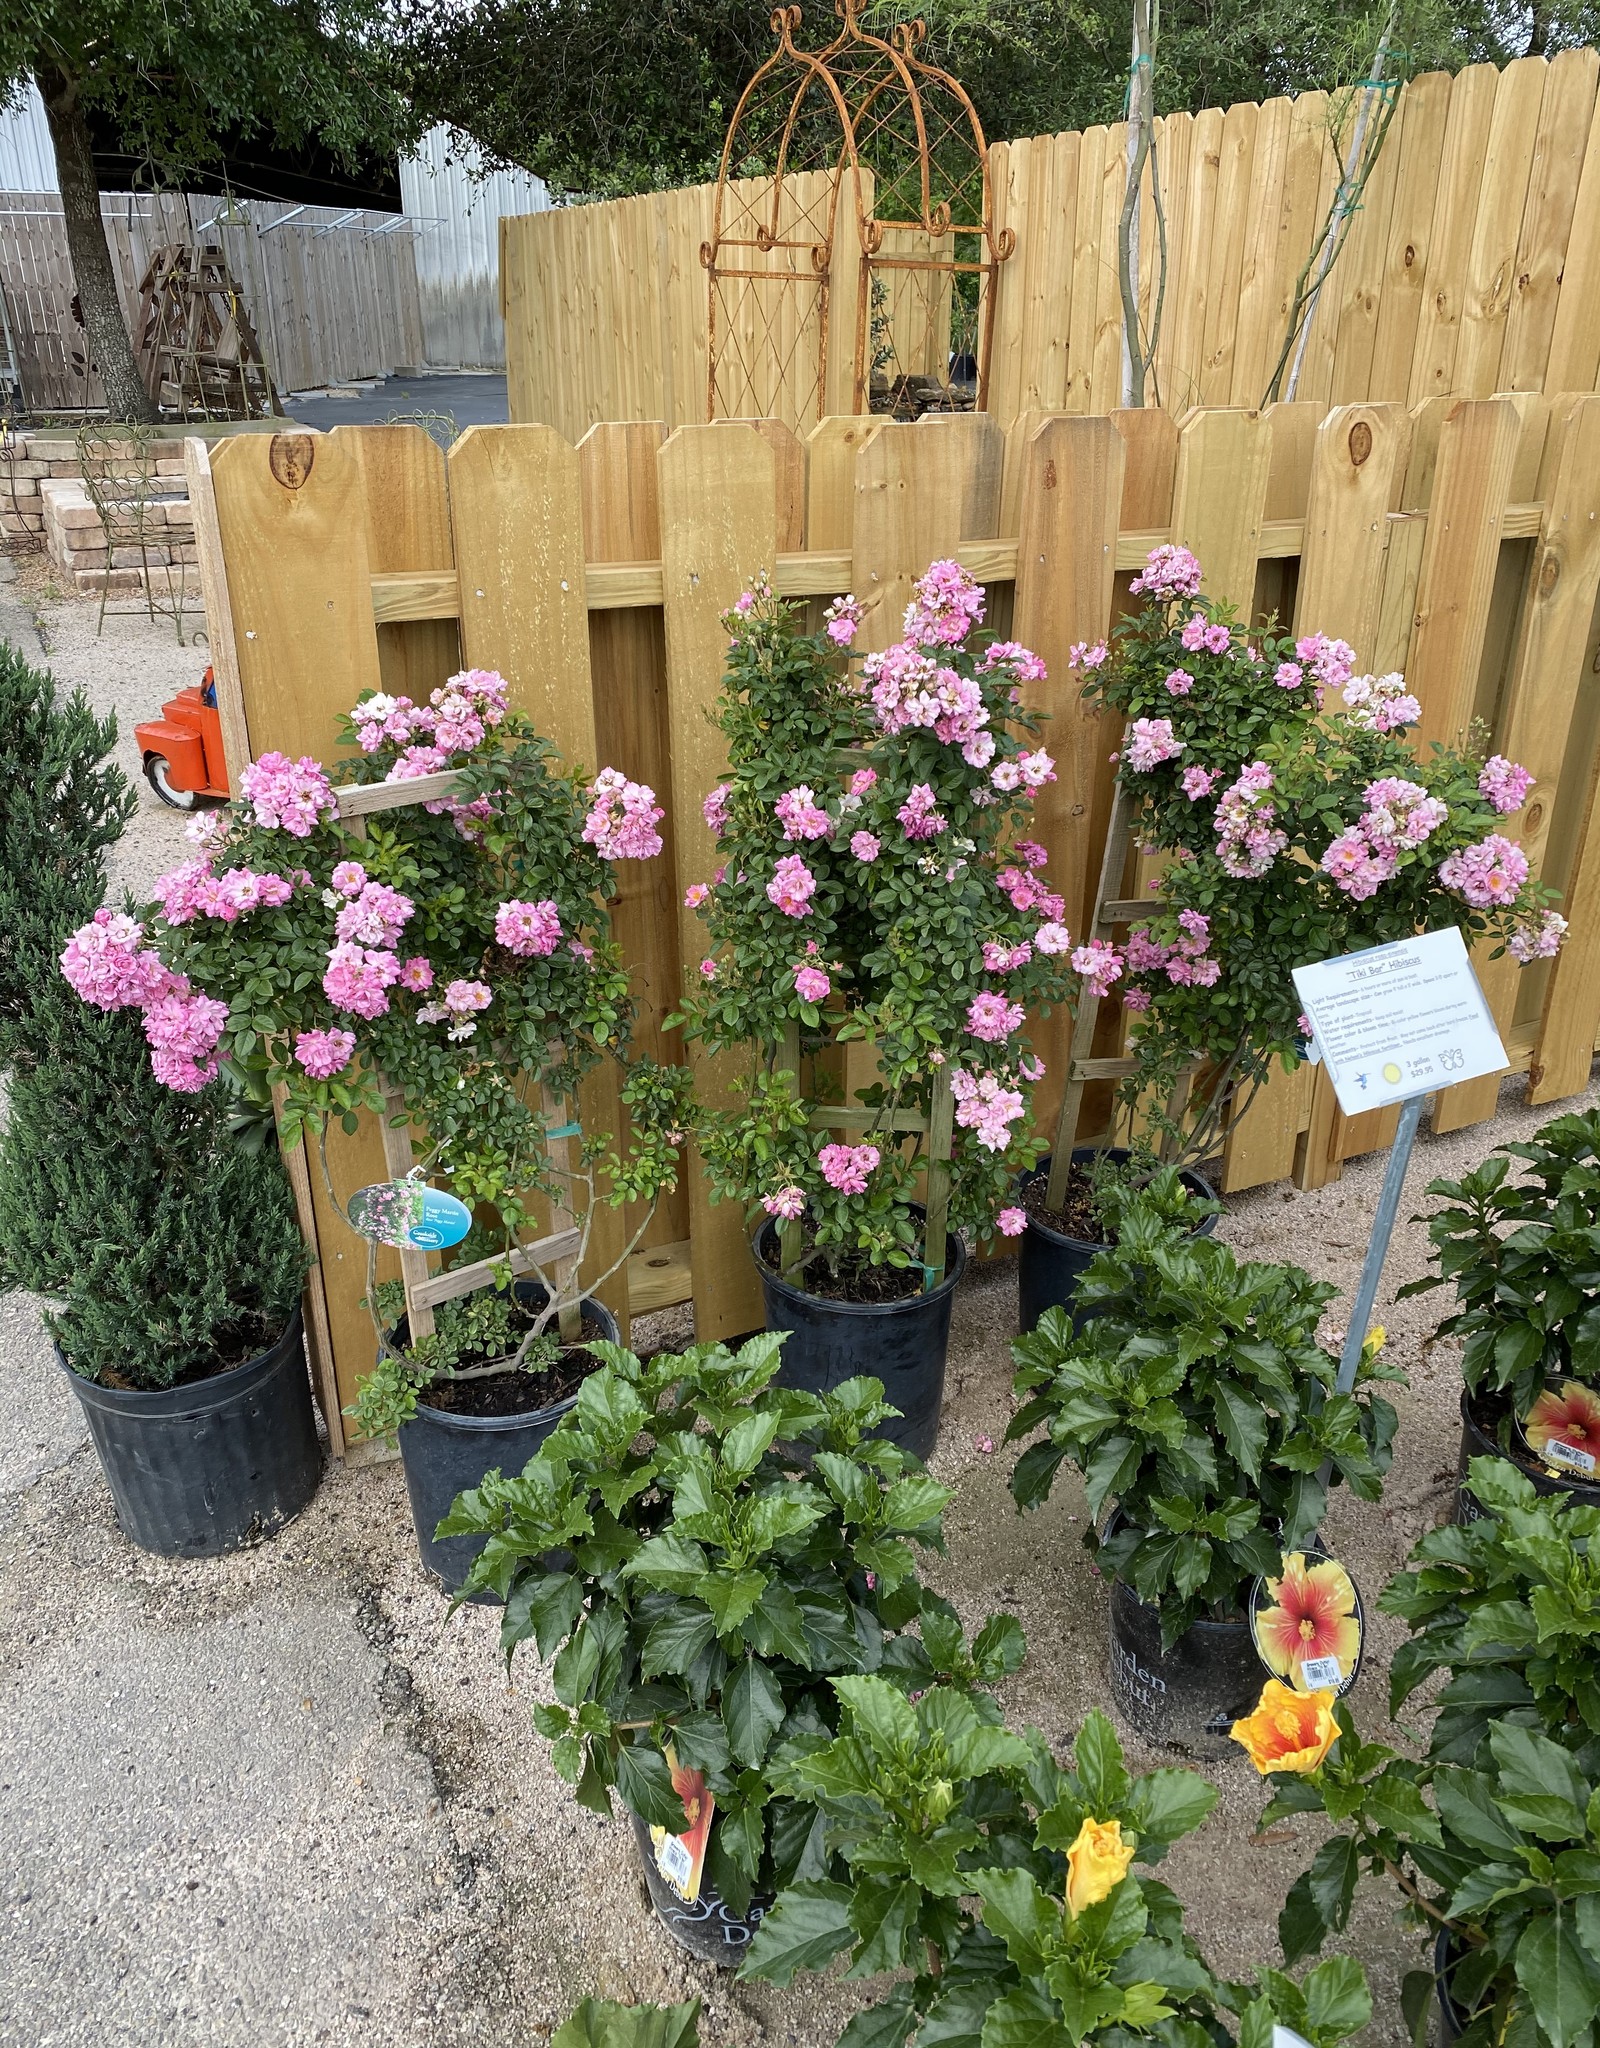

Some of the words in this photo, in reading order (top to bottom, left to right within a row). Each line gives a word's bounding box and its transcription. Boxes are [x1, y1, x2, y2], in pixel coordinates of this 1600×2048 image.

[1346, 968, 1366, 980] "Tiki
[1369, 963, 1386, 974] Bar"
[1389, 954, 1421, 969] Hibiscus
[1312, 997, 1325, 1005] Light
[1326, 988, 1360, 1001] Requirements-
[1315, 1004, 1335, 1013] Average
[1341, 1017, 1375, 1030] requirements-
[1326, 1034, 1343, 1042] Flower
[1412, 1055, 1431, 1068] gallon
[1410, 1065, 1434, 1078] $29.95
[426, 1206, 441, 1214] Peggy
[442, 1208, 459, 1216] Martin
